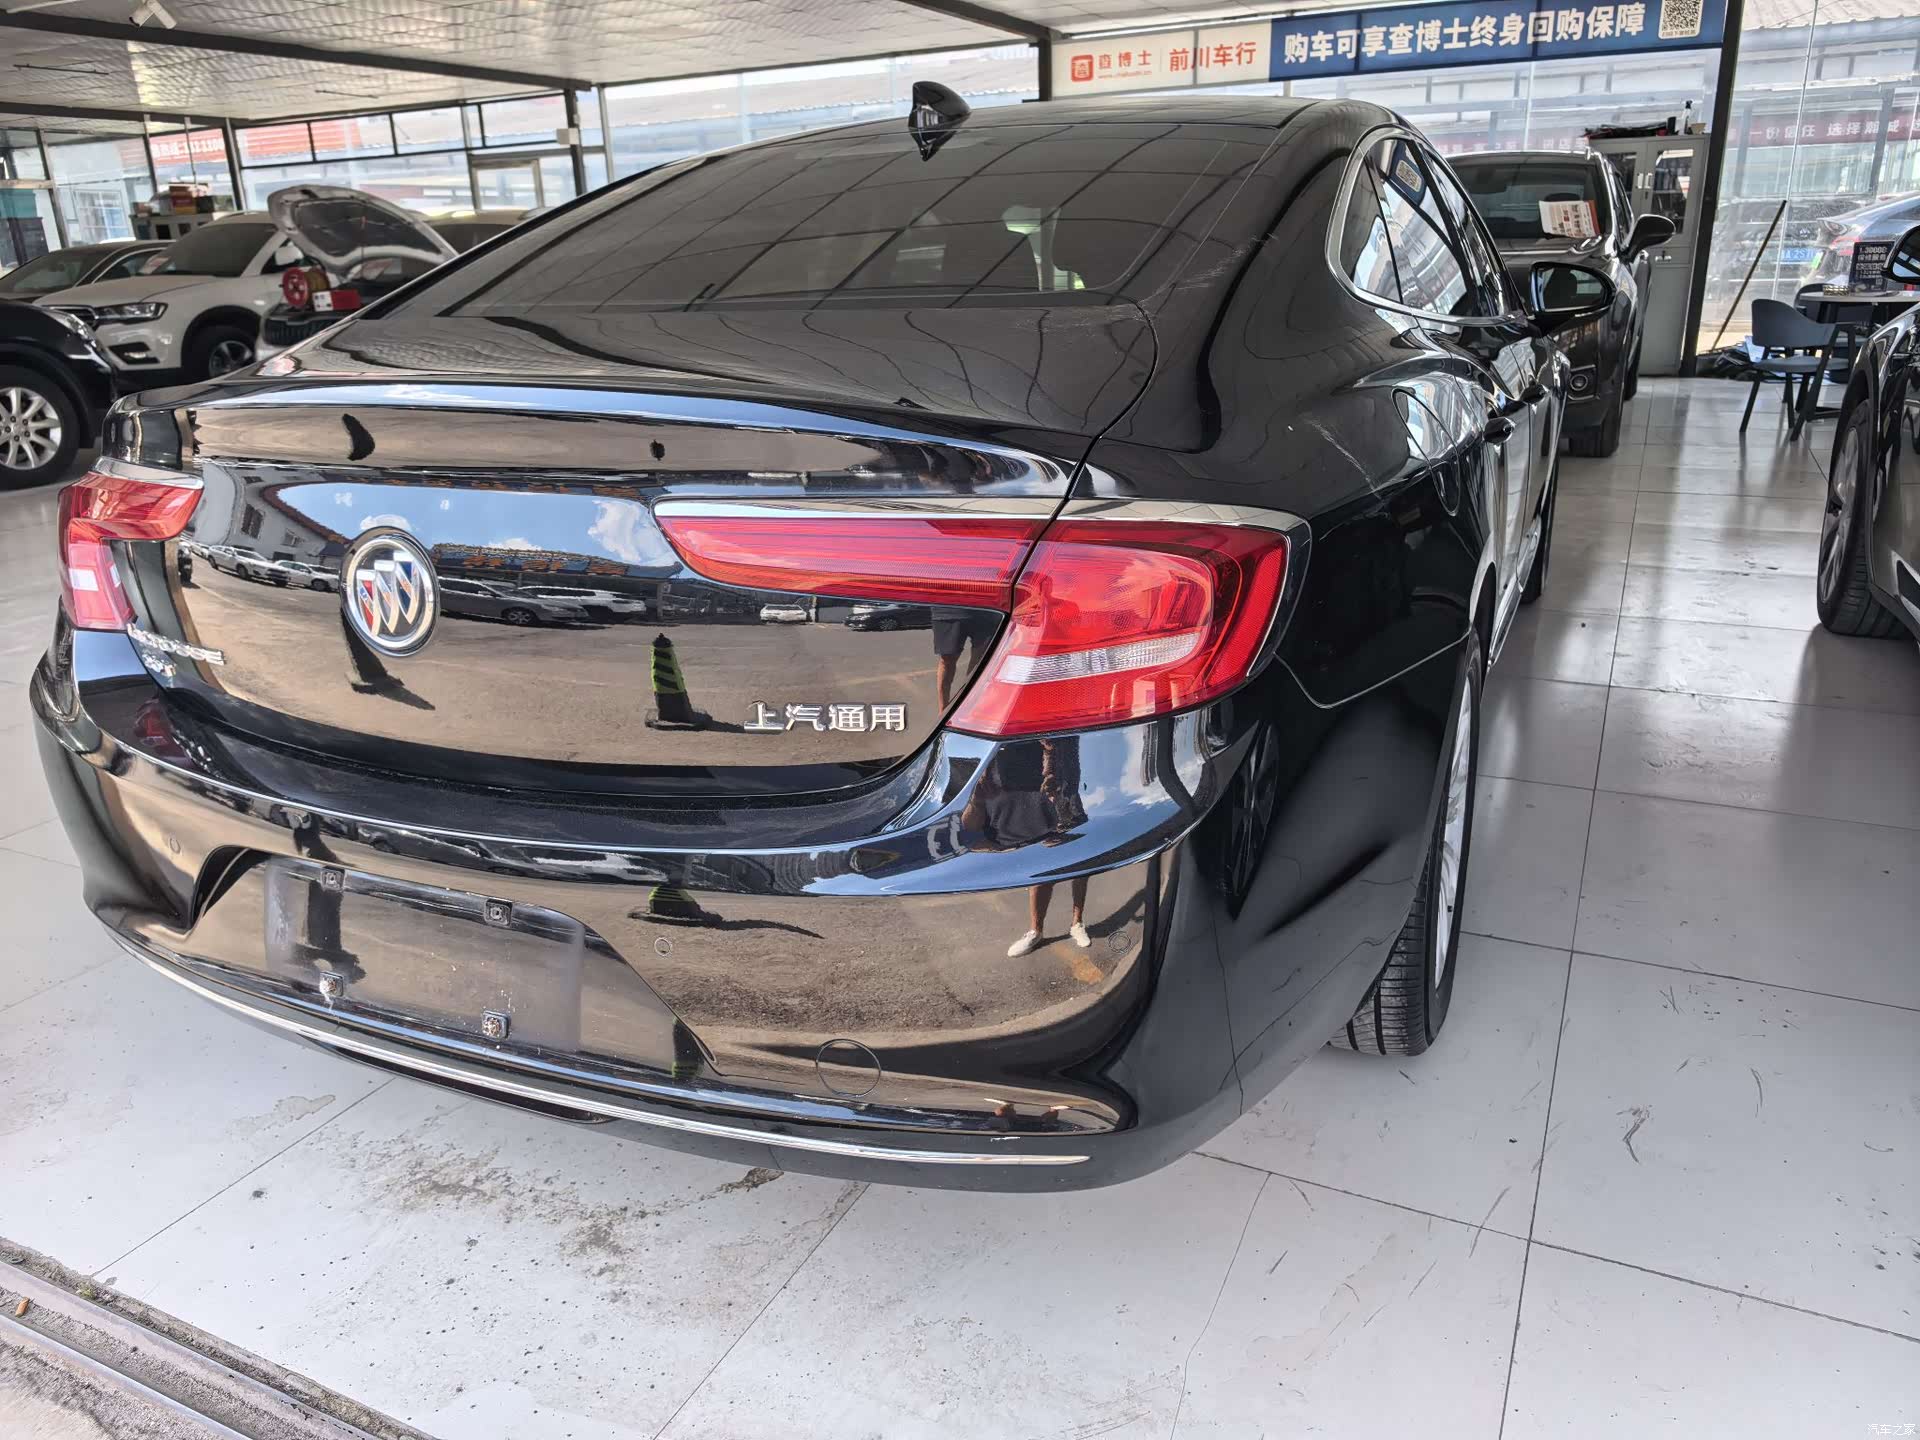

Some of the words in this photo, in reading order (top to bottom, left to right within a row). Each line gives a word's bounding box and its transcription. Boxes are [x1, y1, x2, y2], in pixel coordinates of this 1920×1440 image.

[1284, 2, 1646, 64] 购车可享查博士终身回购保障
[1169, 41, 1257, 72] 前川车行
[743, 701, 908, 733] 上汽通用
